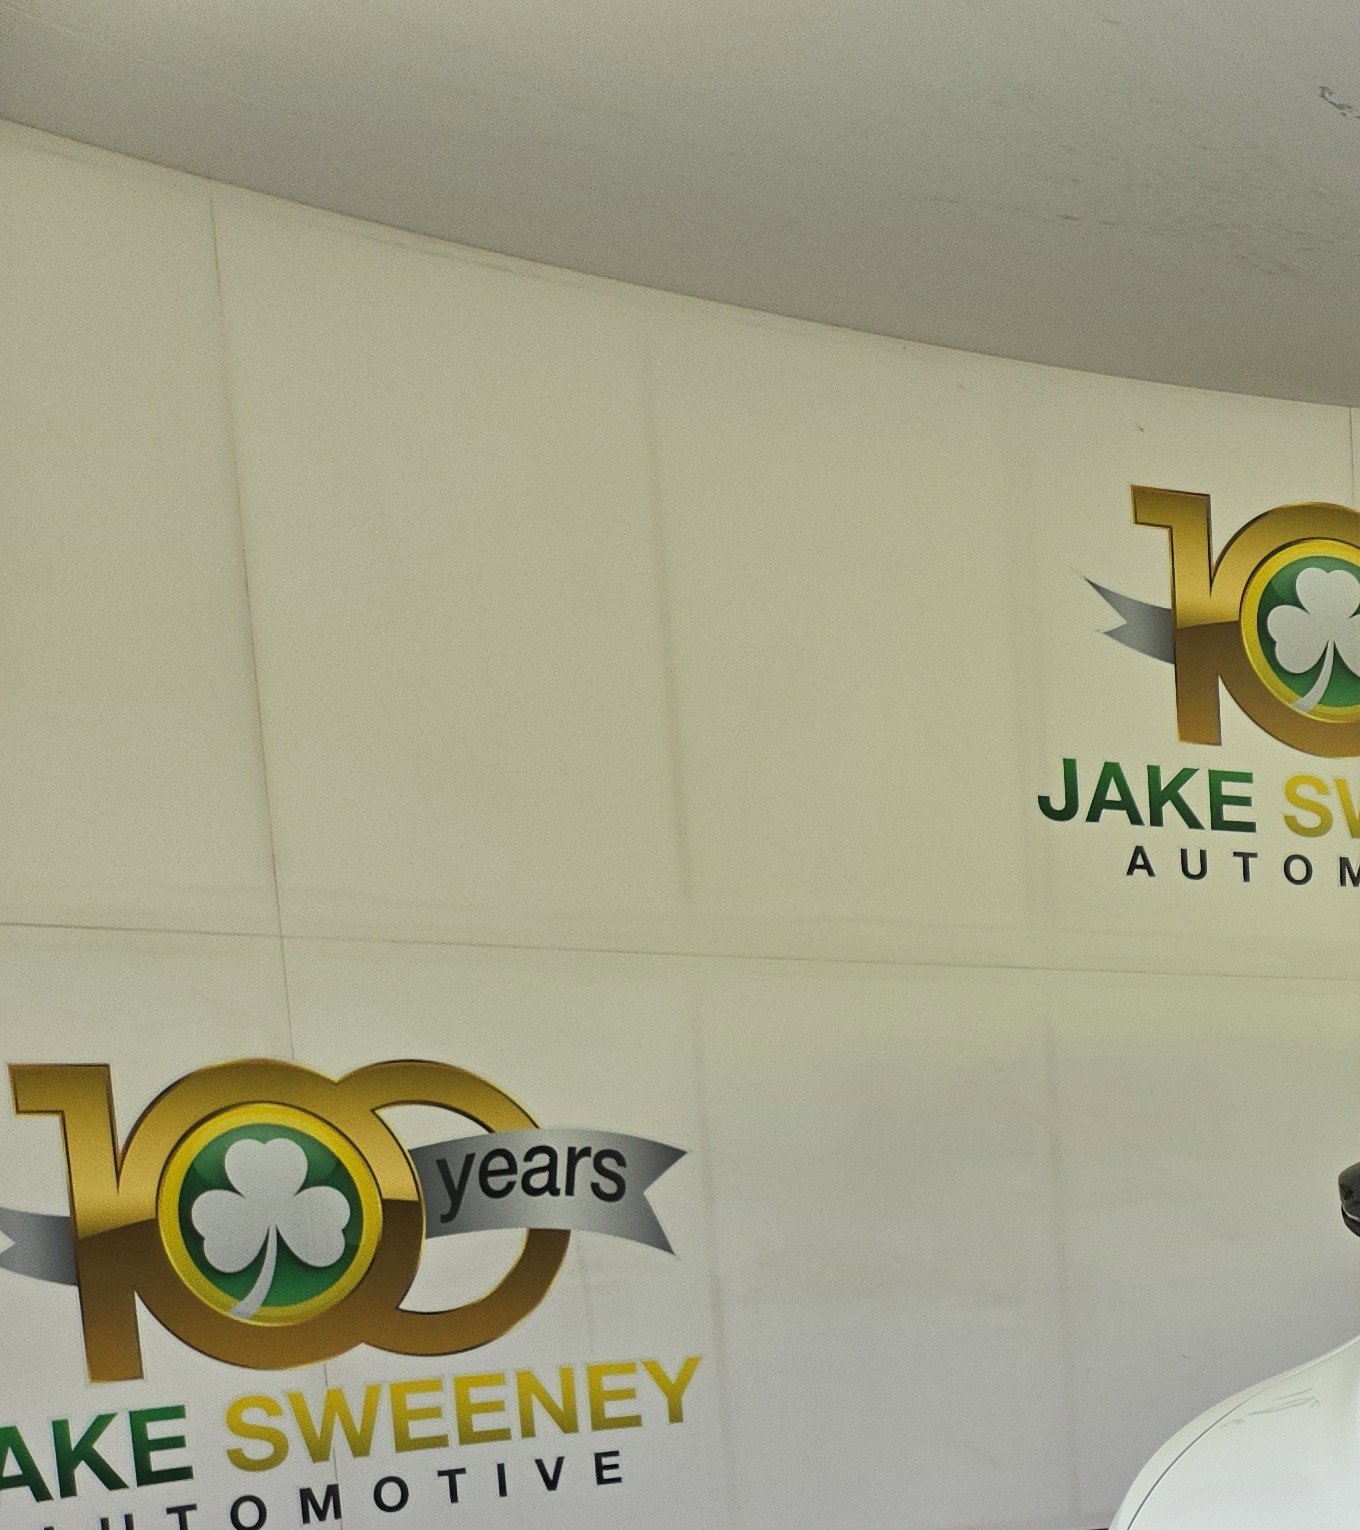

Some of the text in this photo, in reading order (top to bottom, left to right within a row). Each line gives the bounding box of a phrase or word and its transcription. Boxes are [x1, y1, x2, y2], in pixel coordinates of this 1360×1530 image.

[1037, 757, 1257, 833] JAKE
[7, 1058, 627, 1384] 100 years
[0, 1356, 702, 1503] AKE SWEENEY
